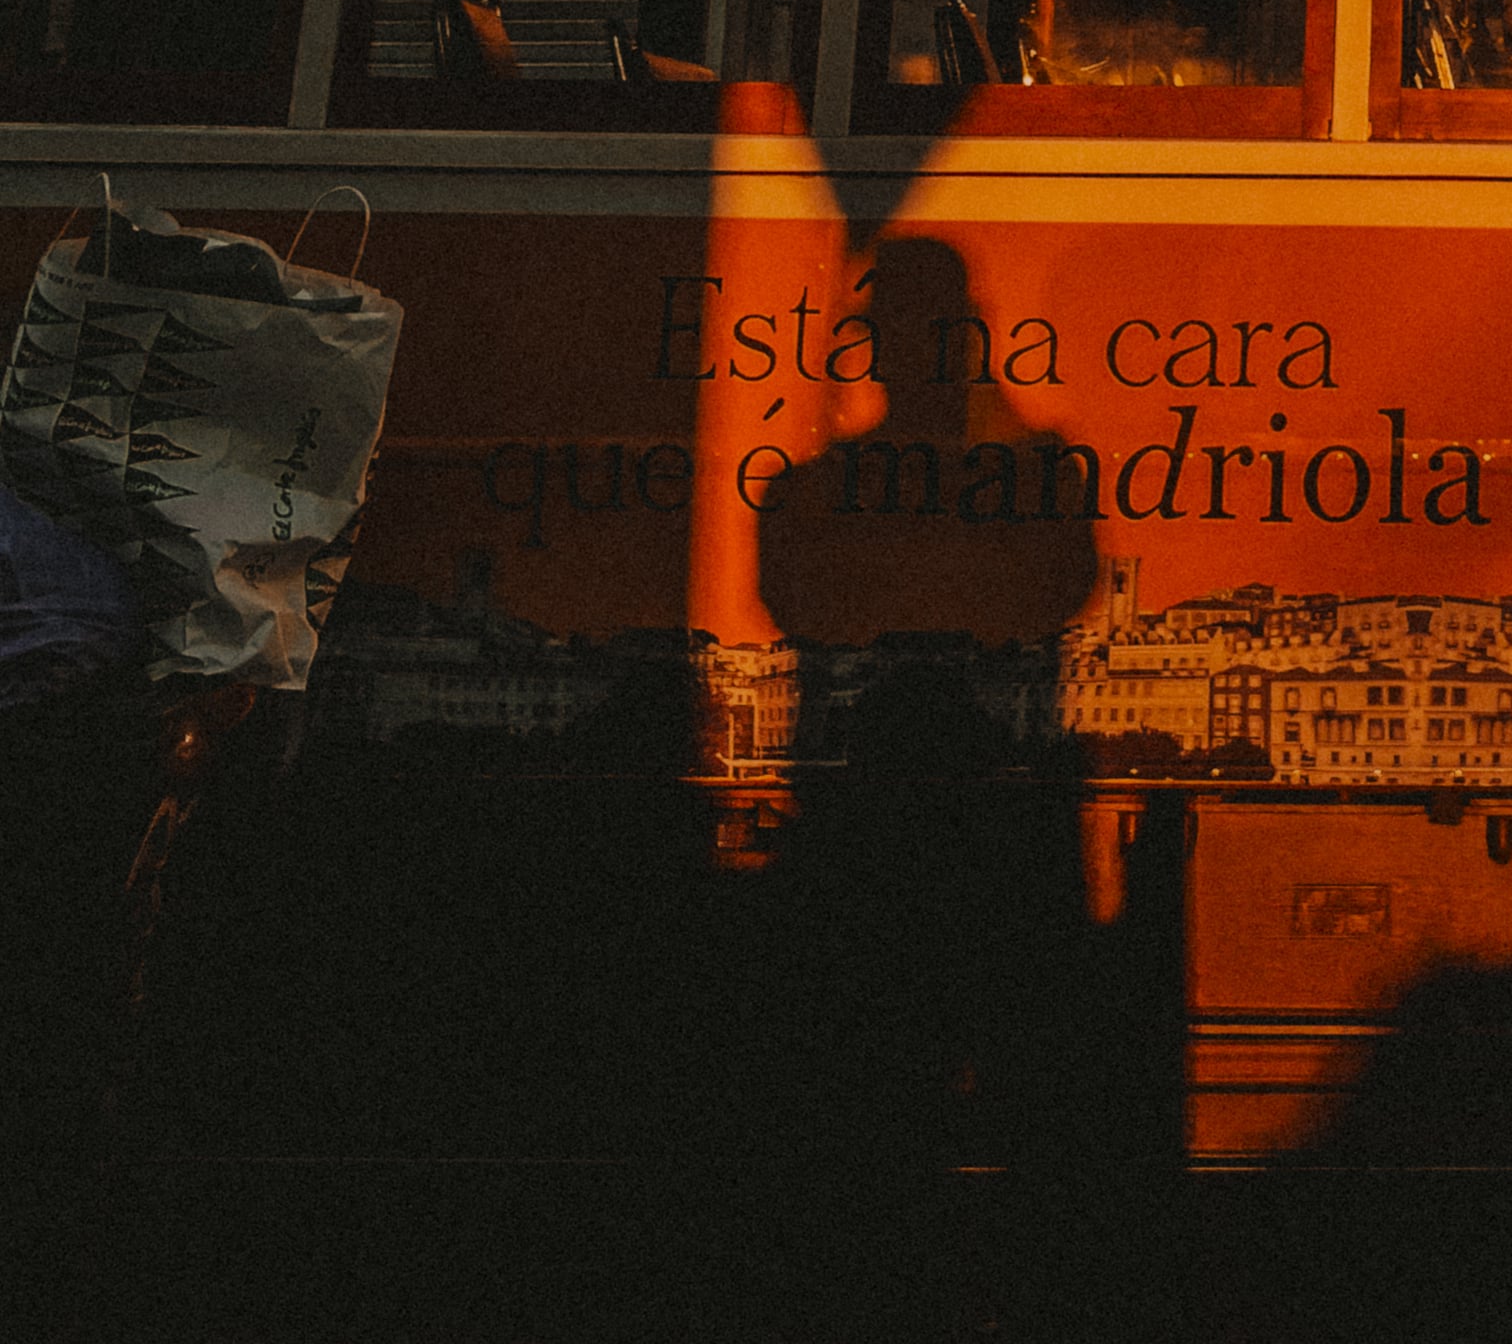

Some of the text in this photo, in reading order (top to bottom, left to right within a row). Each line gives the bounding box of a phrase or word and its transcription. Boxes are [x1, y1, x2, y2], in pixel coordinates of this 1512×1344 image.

[655, 266, 1338, 392] Está na cara
[482, 397, 1494, 549] que é mandriola
